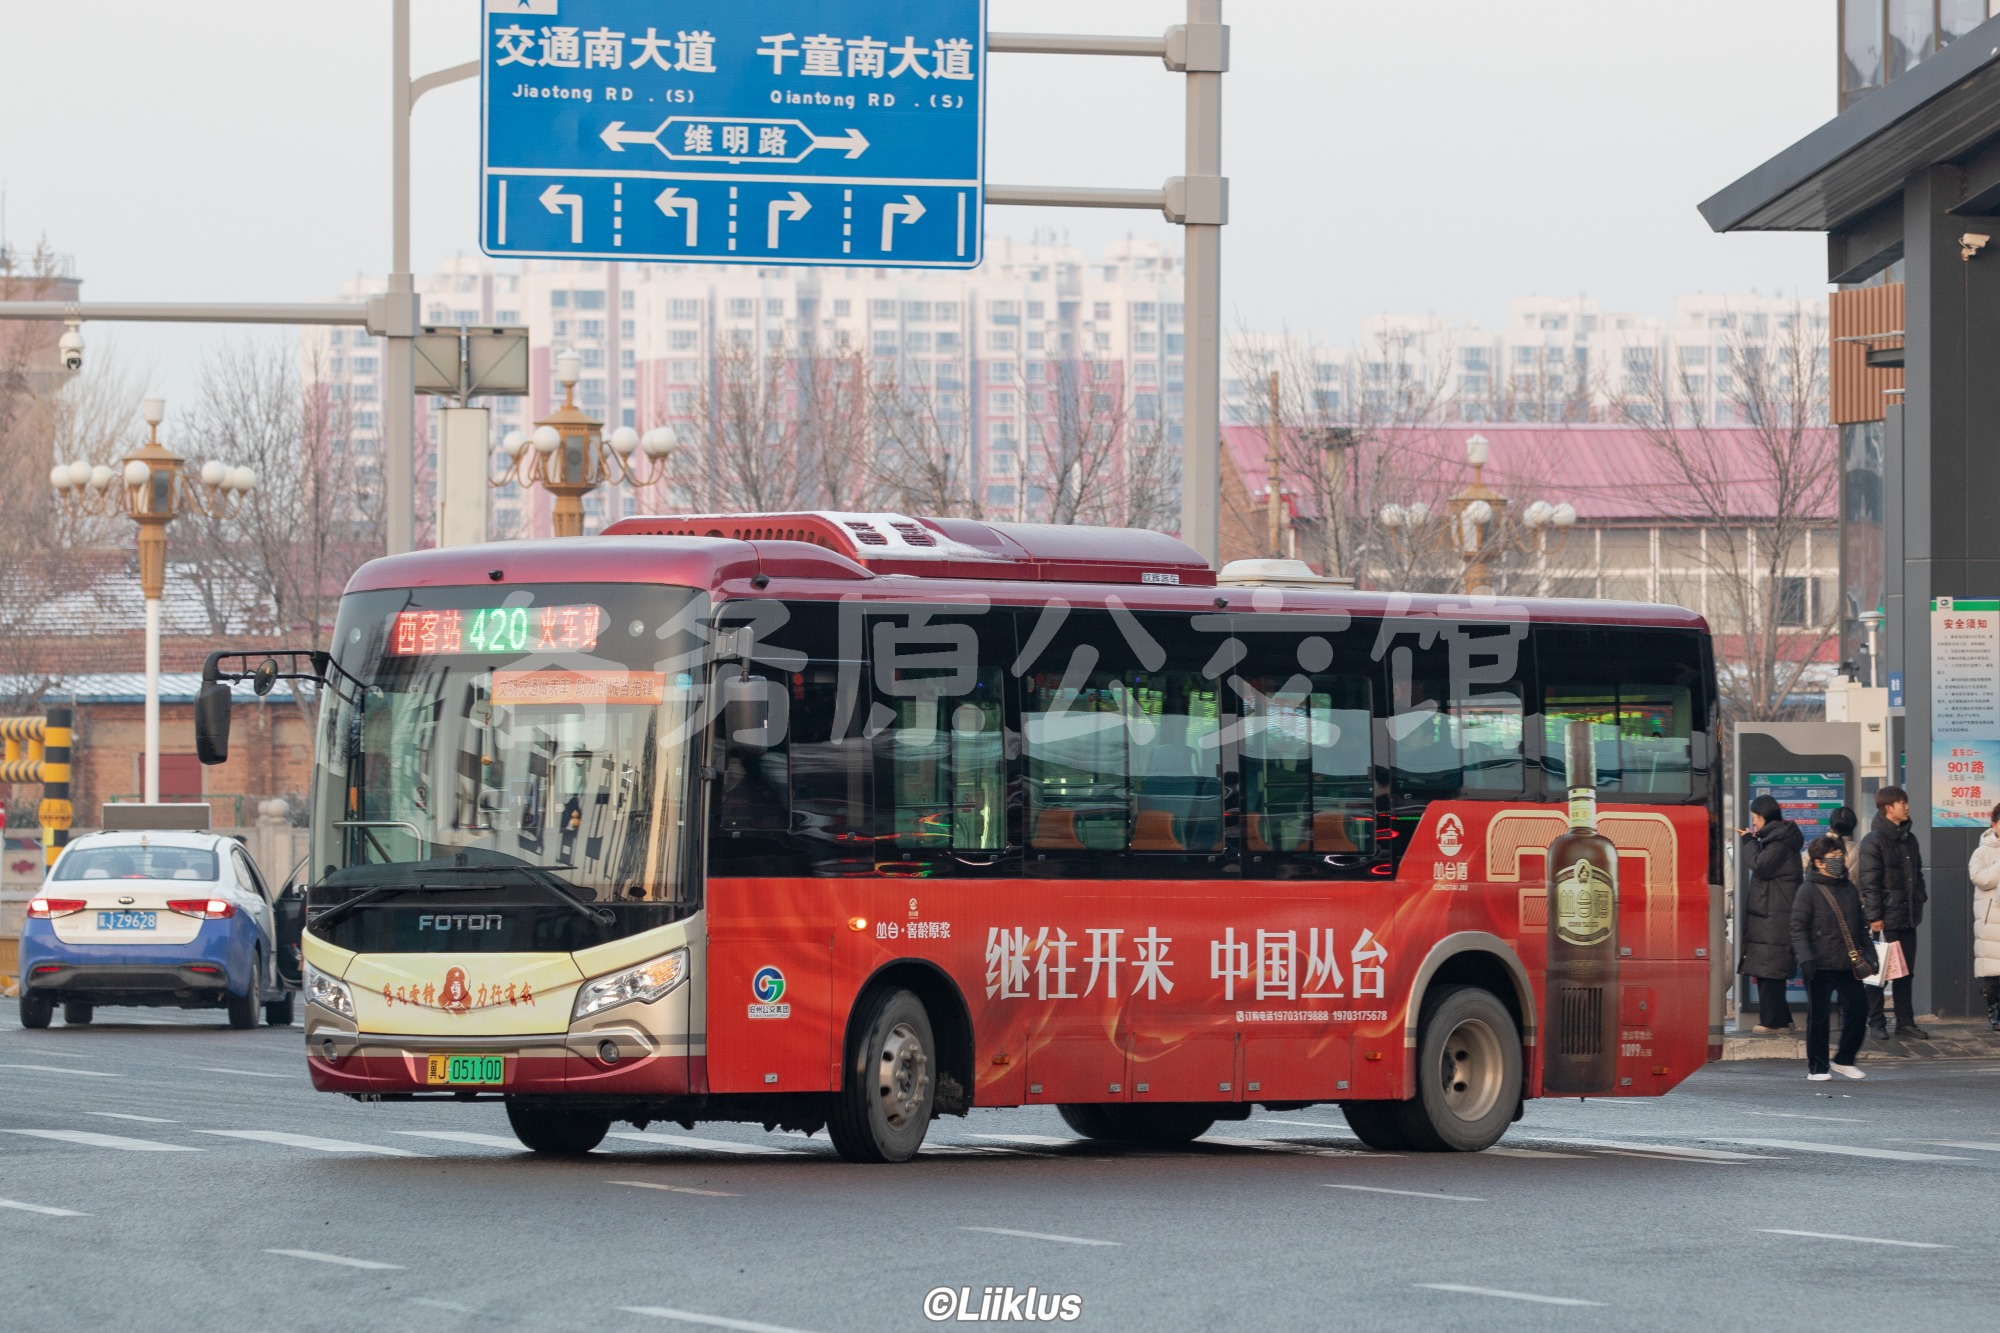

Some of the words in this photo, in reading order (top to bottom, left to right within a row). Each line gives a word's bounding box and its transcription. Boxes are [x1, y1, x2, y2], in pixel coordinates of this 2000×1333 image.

[495, 24, 718, 74] 交通南大道
[756, 33, 976, 81] 千童南大道
[512, 84, 593, 103] Jiaotong
[606, 87, 634, 102] RD
[770, 90, 856, 110] Qiantong
[868, 93, 896, 108] RD
[683, 124, 788, 157] 维明路
[397, 610, 462, 655] 西客站
[469, 608, 528, 652] 420
[1944, 618, 1988, 630] 安全须知
[1948, 761, 1984, 773] 901路
[1951, 786, 1981, 799] 907路
[1433, 861, 1468, 881] 丛台酒
[419, 914, 503, 931] FOTON
[985, 926, 1175, 1001] 继往开来
[1210, 927, 1389, 1001] 中国丛台
[383, 981, 435, 1008] 学习雷锋
[1332, 1010, 1388, 1021] 19703175678
